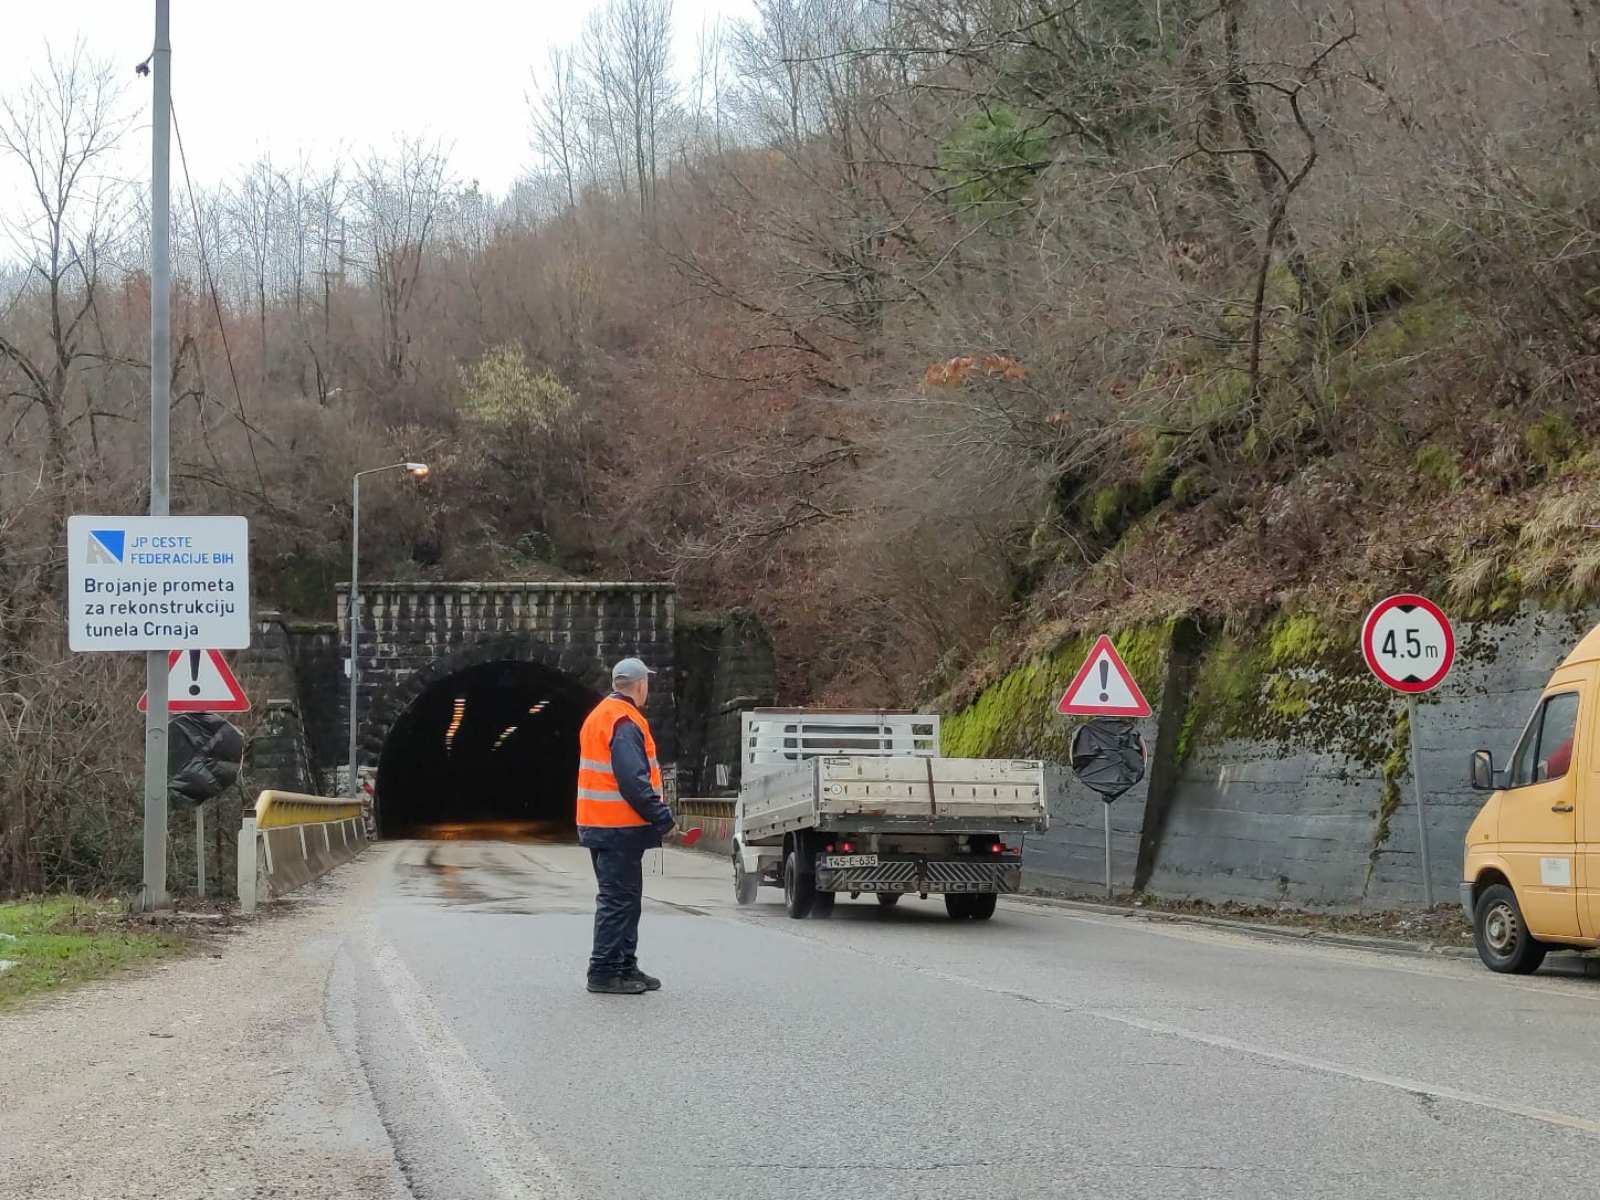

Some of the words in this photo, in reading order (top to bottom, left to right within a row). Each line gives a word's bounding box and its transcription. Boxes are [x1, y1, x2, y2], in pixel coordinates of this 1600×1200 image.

[131, 536, 149, 548] JP
[152, 536, 193, 548] CESTE
[131, 552, 209, 565] FEDERACIJE
[213, 552, 234, 565] BIH
[85, 578, 158, 596] Brojanje
[163, 578, 235, 595] prometa
[85, 603, 105, 615] za
[110, 600, 235, 617] rekonstrukciju
[86, 622, 138, 637] tunela
[144, 621, 199, 639] Crnaja
[1382, 628, 1421, 659] 4.5
[1425, 645, 1438, 658] m
[847, 882, 905, 891] LONG
[913, 882, 992, 892] EHICLE
